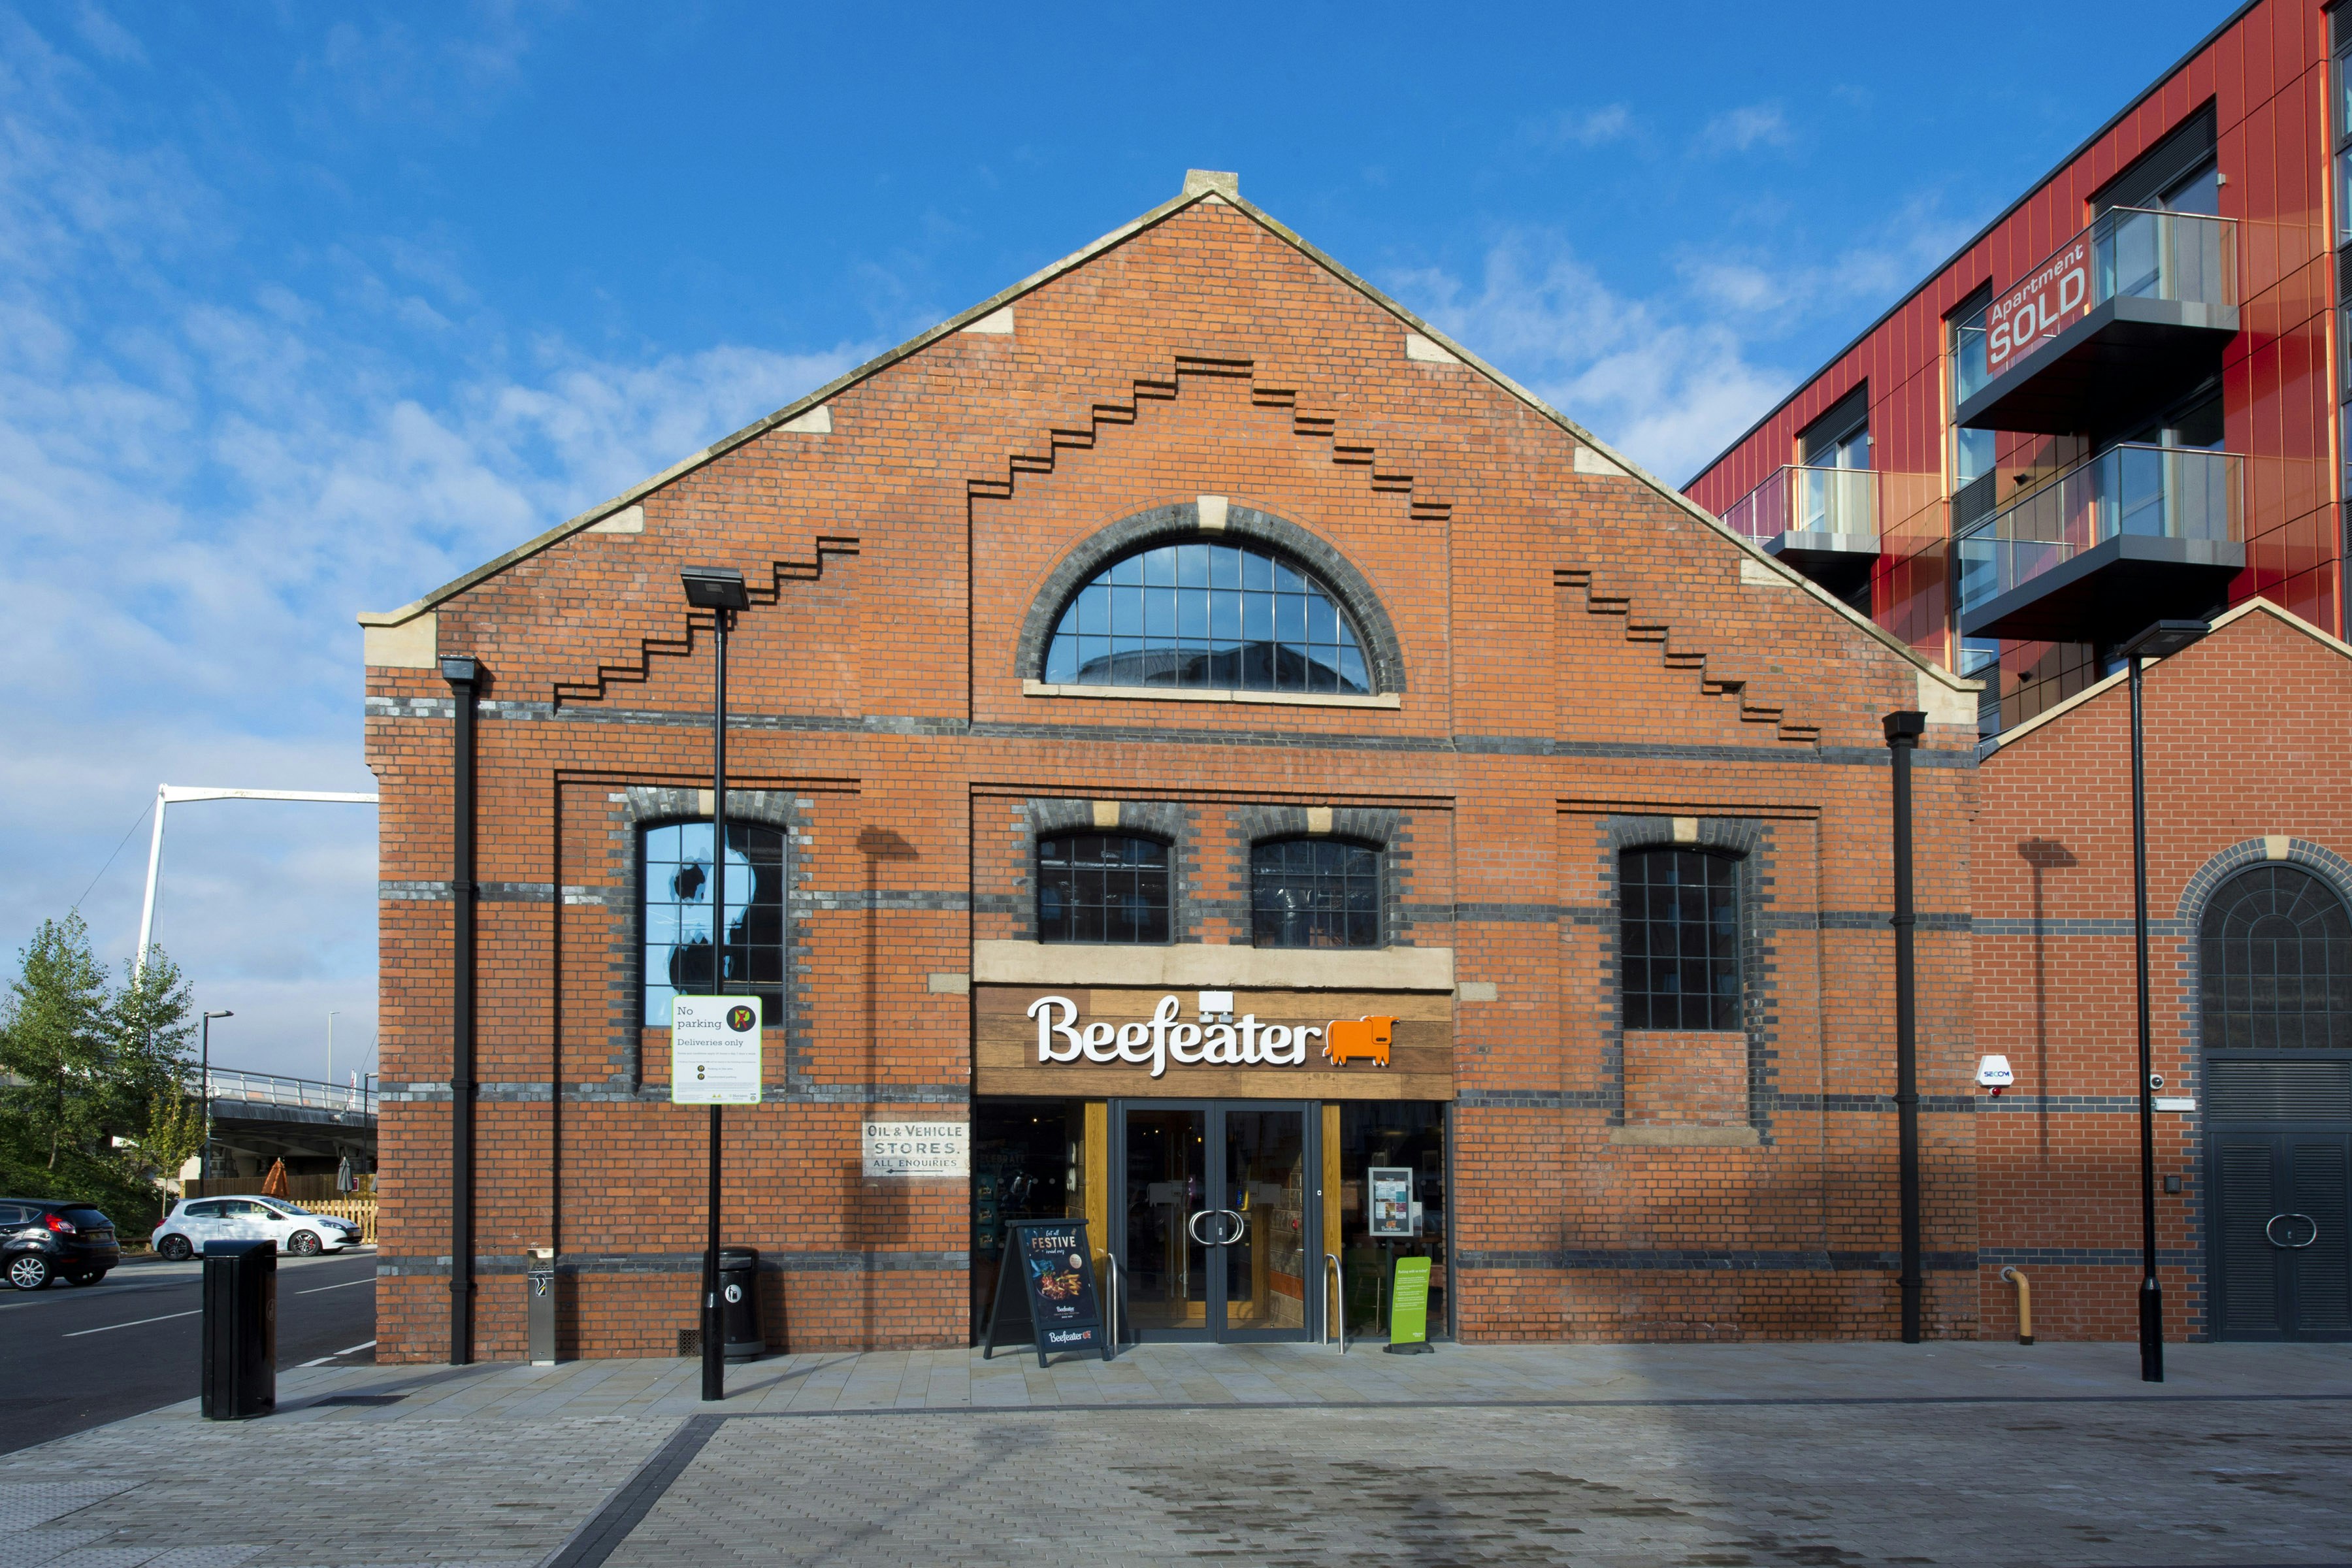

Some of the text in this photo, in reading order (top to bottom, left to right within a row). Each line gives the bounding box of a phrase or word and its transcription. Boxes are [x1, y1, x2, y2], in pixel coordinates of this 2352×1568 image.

[1991, 244, 2083, 325] Apartment
[1990, 267, 2085, 364] SOLD
[677, 1006, 694, 1015] No
[677, 1019, 722, 1030] parking
[1027, 994, 1322, 1077] Beefeater
[725, 1039, 743, 1048] only
[868, 1125, 962, 1137] OIL & VEHICLE
[875, 1143, 960, 1154] STORES.
[1032, 1236, 1077, 1249] FESTIVE
[1048, 1330, 1083, 1344] Beefeater
